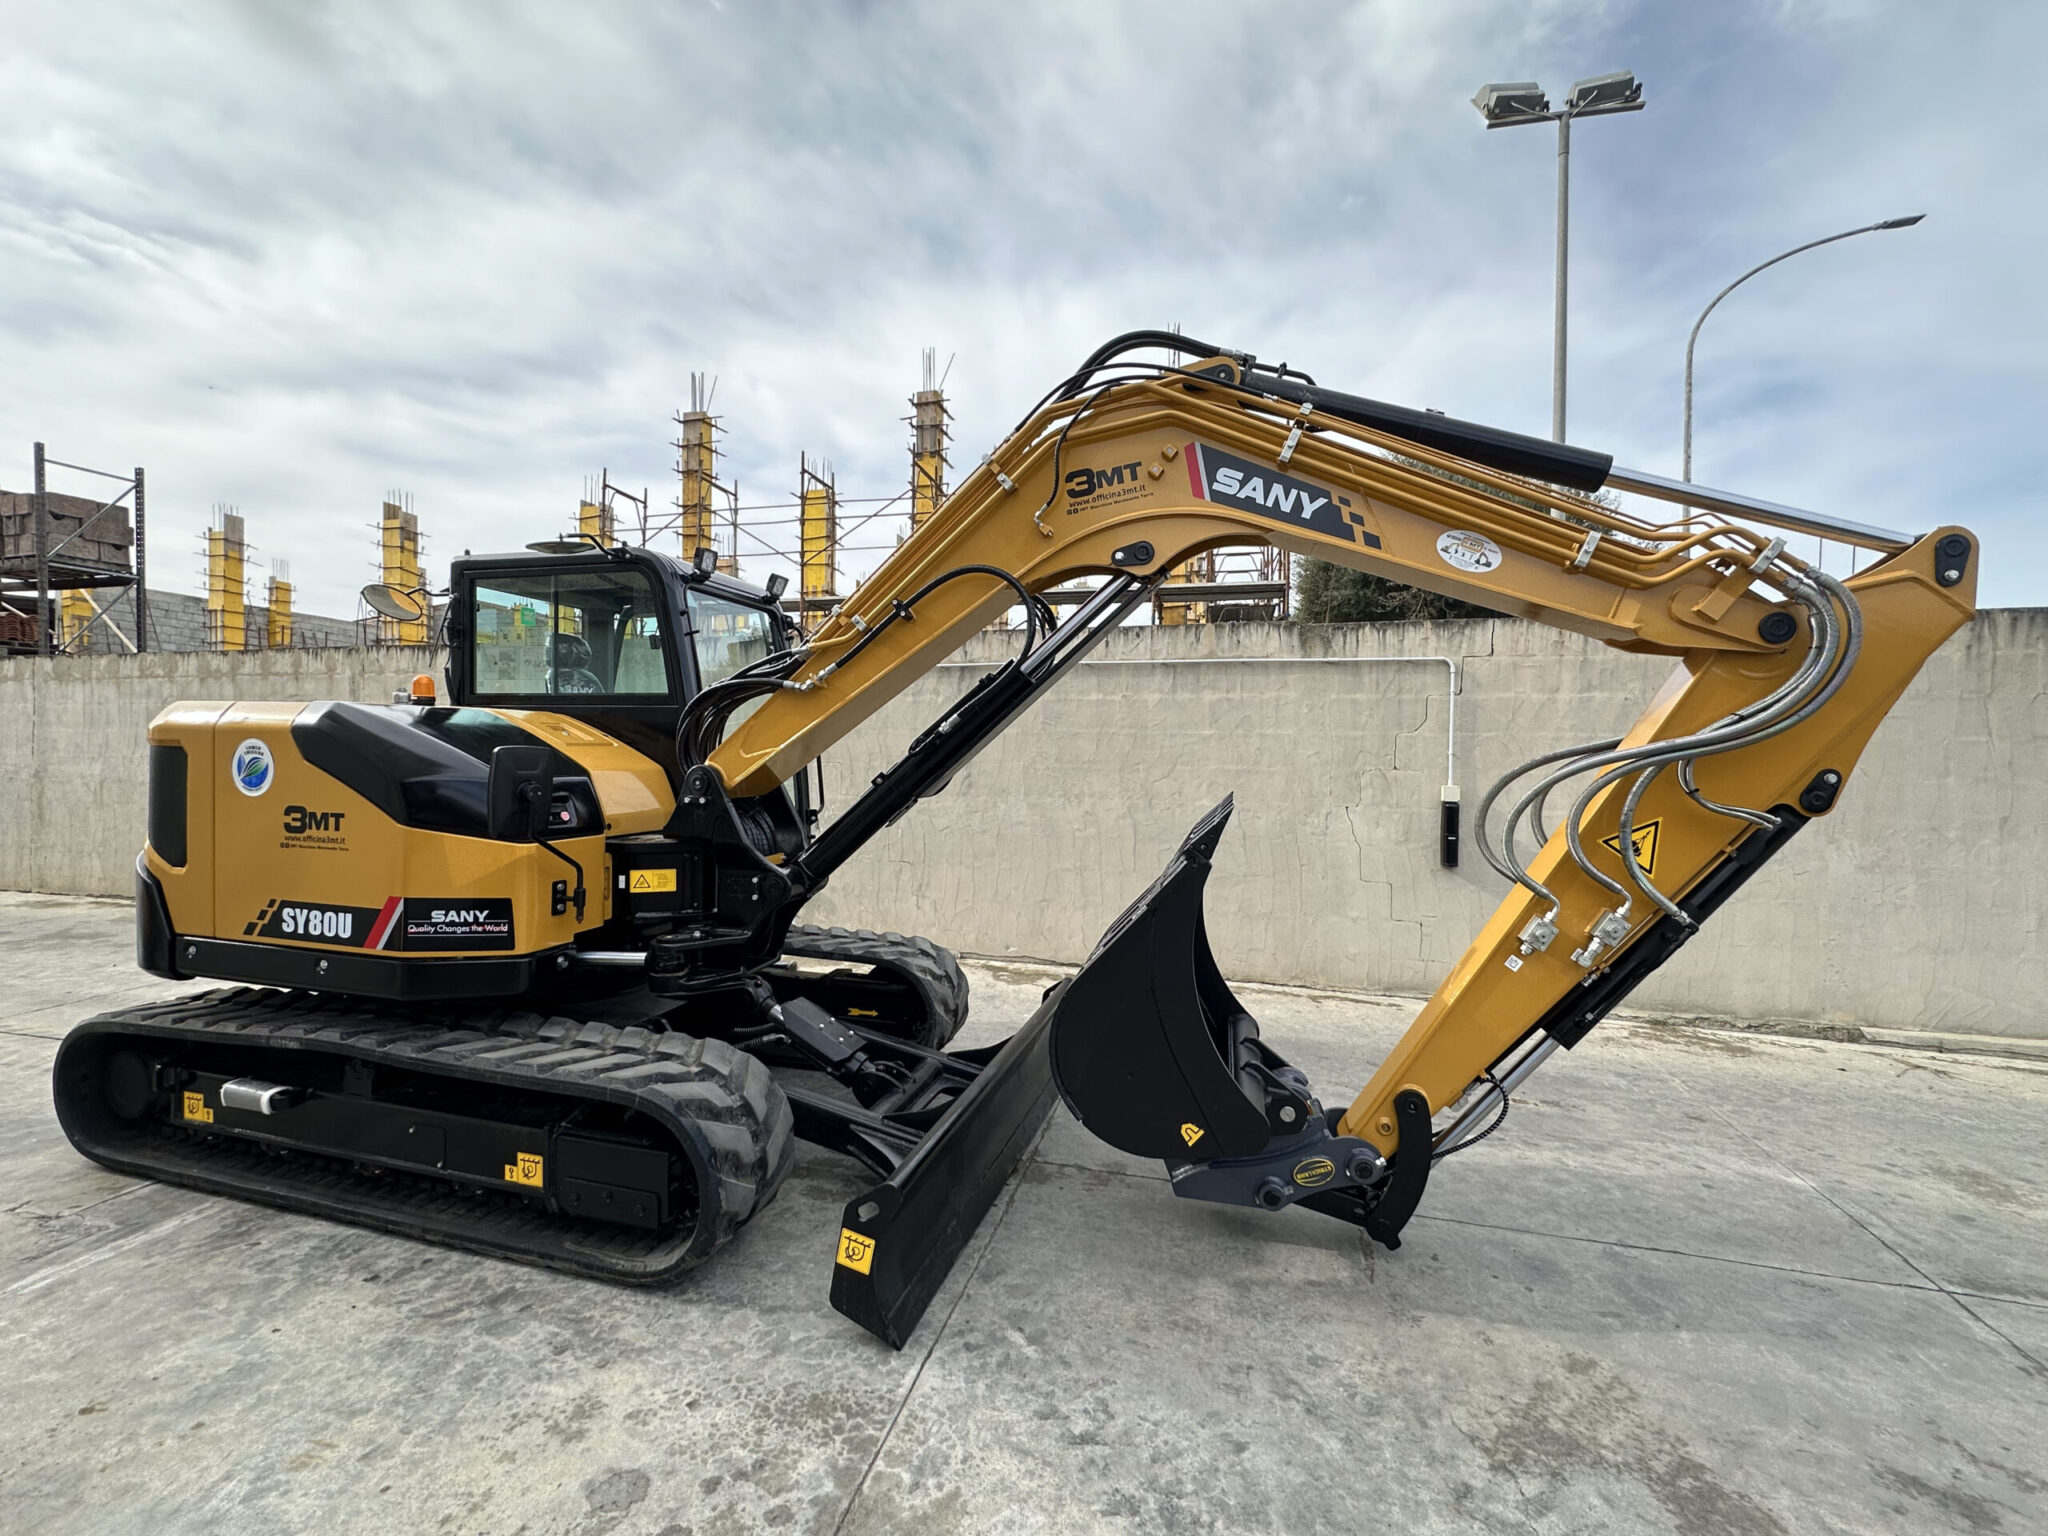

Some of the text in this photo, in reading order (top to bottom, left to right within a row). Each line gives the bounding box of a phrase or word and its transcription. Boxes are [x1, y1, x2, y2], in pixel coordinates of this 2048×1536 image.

[1065, 461, 1142, 499] 3MT
[1212, 467, 1329, 520] SANY
[1069, 484, 1147, 508] www.officina3mt.it
[284, 805, 345, 834] 3MT
[281, 907, 353, 939] SY80U
[407, 923, 508, 934] Quality Changes the World
[431, 910, 490, 922] SANY
